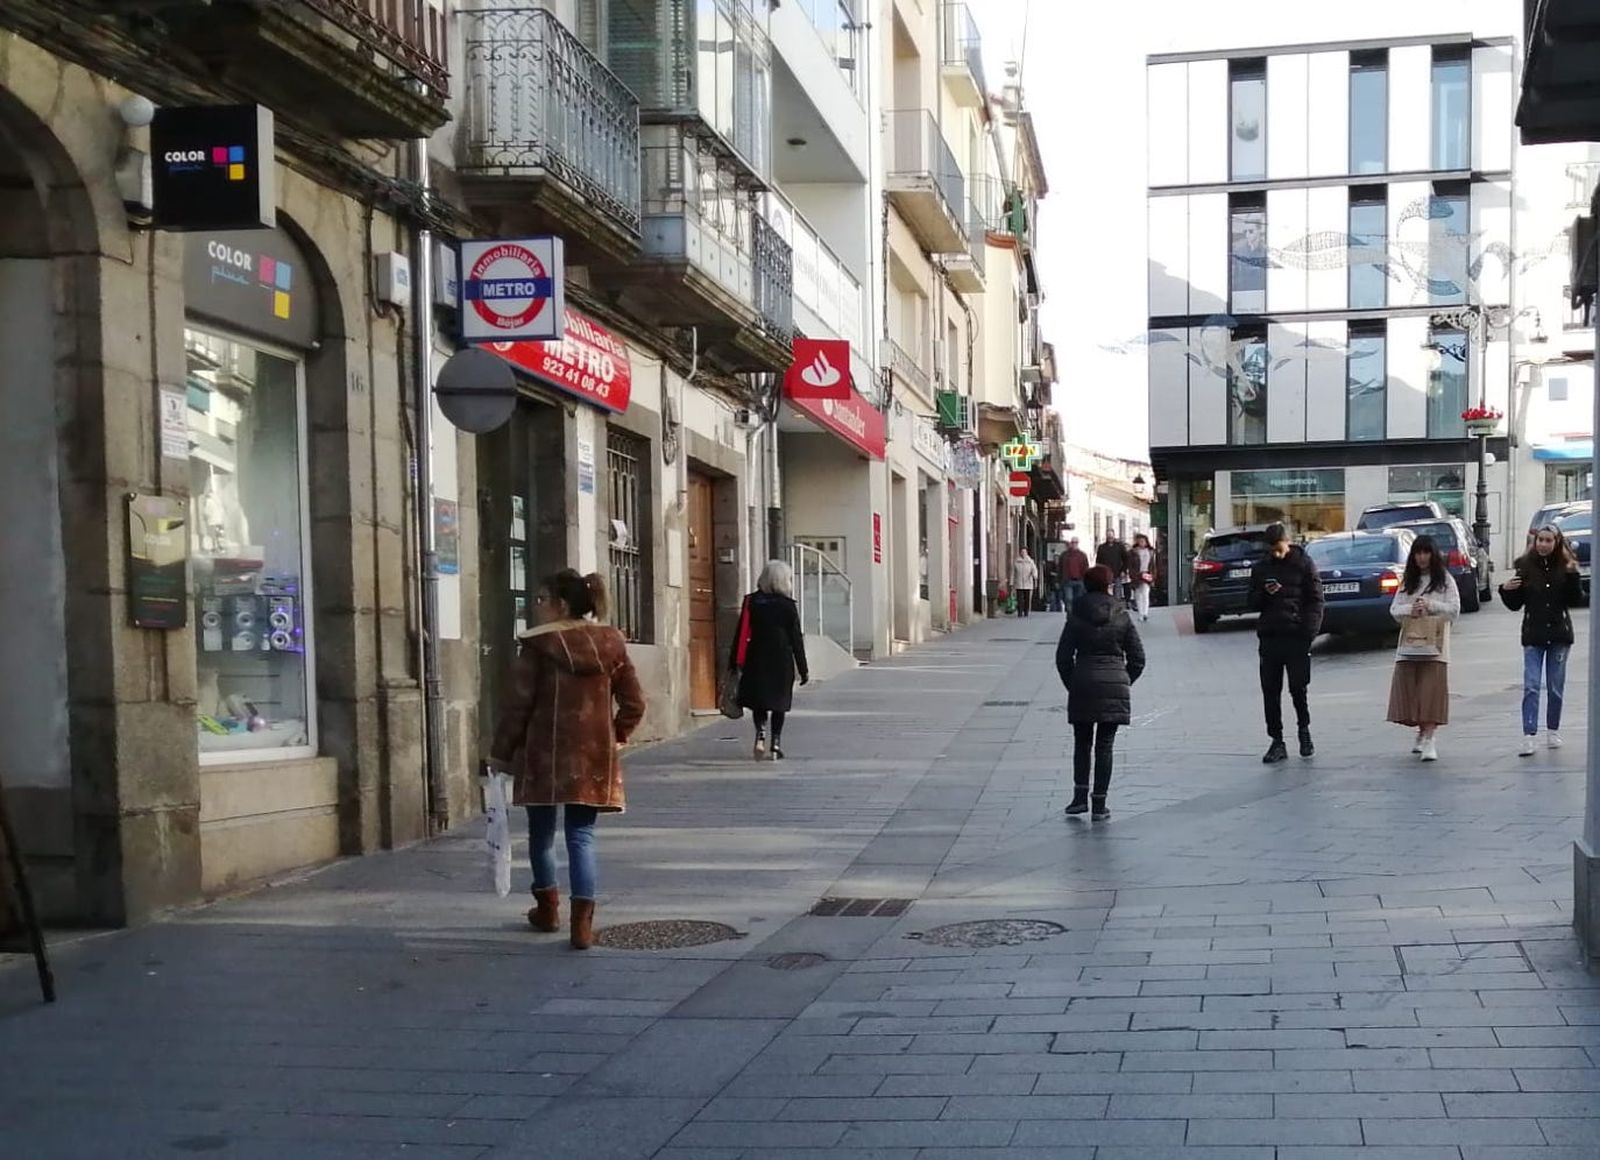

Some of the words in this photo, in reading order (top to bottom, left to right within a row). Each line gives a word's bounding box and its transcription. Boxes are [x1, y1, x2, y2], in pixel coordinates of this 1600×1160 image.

[164, 150, 206, 162] COLOR
[207, 241, 252, 271] COLOR
[472, 246, 541, 277] Inmobiliaria
[482, 282, 536, 297] METRO
[543, 333, 614, 383] METRO
[542, 356, 565, 377] 923
[565, 369, 580, 384] 41
[595, 383, 610, 398] 43
